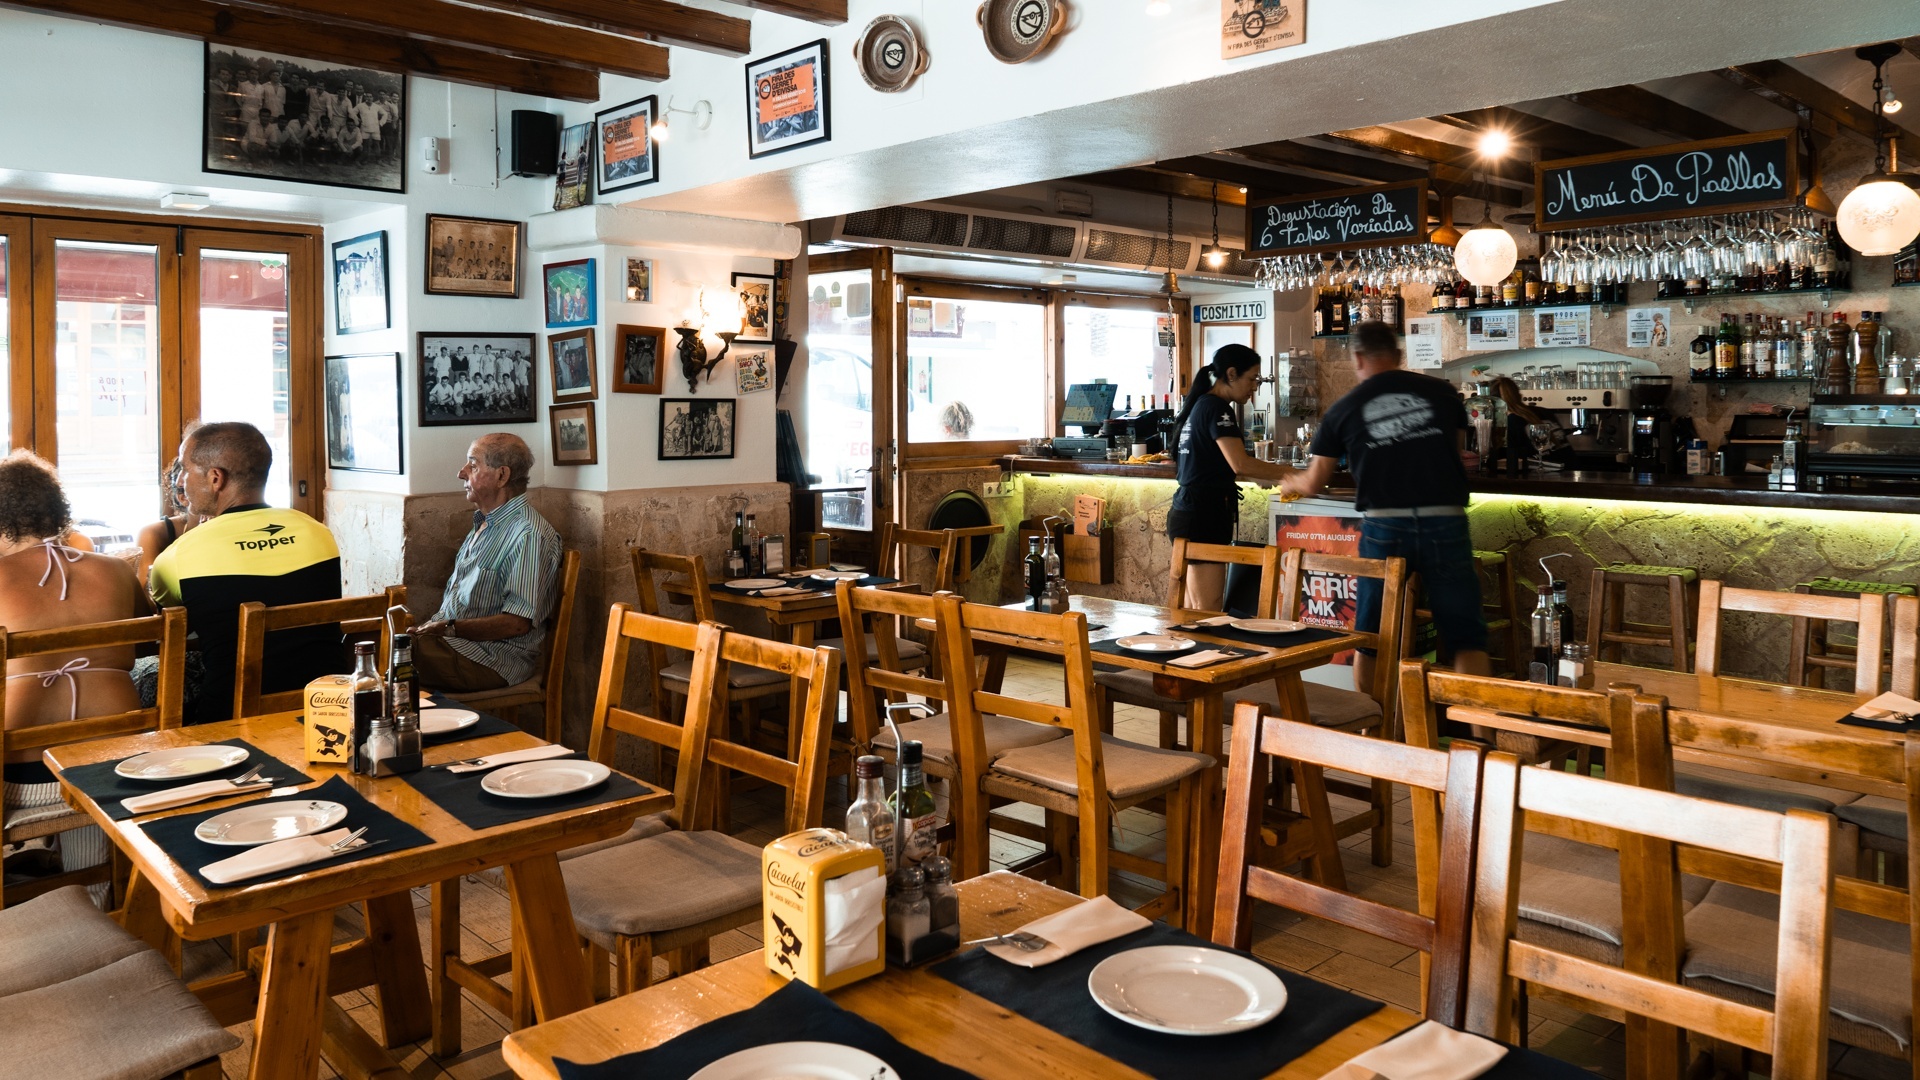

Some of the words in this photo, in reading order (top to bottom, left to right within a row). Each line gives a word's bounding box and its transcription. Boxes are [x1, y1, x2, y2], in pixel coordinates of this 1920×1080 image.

[772, 74, 783, 83] FIRA
[784, 70, 795, 79] DES
[772, 78, 794, 90] GERRET
[1547, 170, 1625, 215] Menú
[1630, 164, 1679, 204] De
[1676, 151, 1782, 204] Paellas
[1268, 197, 1361, 229] Degustación
[1372, 193, 1396, 215] De
[1260, 227, 1273, 247] 6
[1279, 222, 1330, 246] Tapas
[1337, 214, 1414, 242] Variadas
[1201, 303, 1263, 320] COSMITITO
[234, 535, 296, 551] Topper
[1286, 532, 1309, 540] FRIDAY
[1310, 533, 1326, 541] 07TH
[1326, 534, 1356, 542] AUGUST
[1308, 599, 1336, 618] MK
[1302, 617, 1320, 625] TYSON
[1321, 618, 1344, 626] O'BRIEN
[310, 691, 350, 709] Cacaolat
[767, 861, 806, 897] Cacaolat
